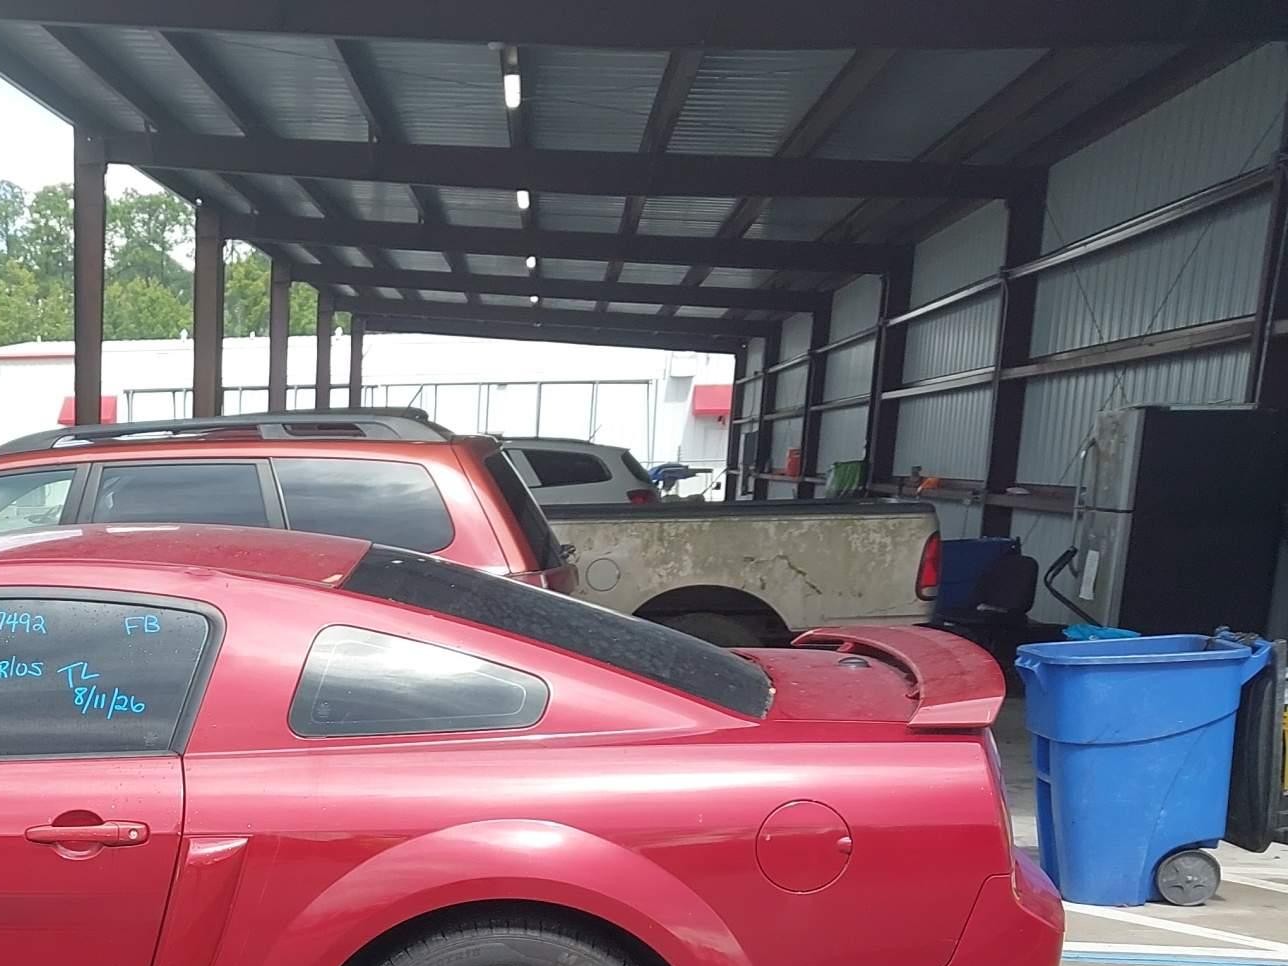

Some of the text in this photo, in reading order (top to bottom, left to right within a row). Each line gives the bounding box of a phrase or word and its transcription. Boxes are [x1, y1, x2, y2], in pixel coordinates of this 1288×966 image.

[124, 614, 161, 635] FB
[57, 661, 100, 688] TL
[74, 685, 145, 719] 8/11/26
